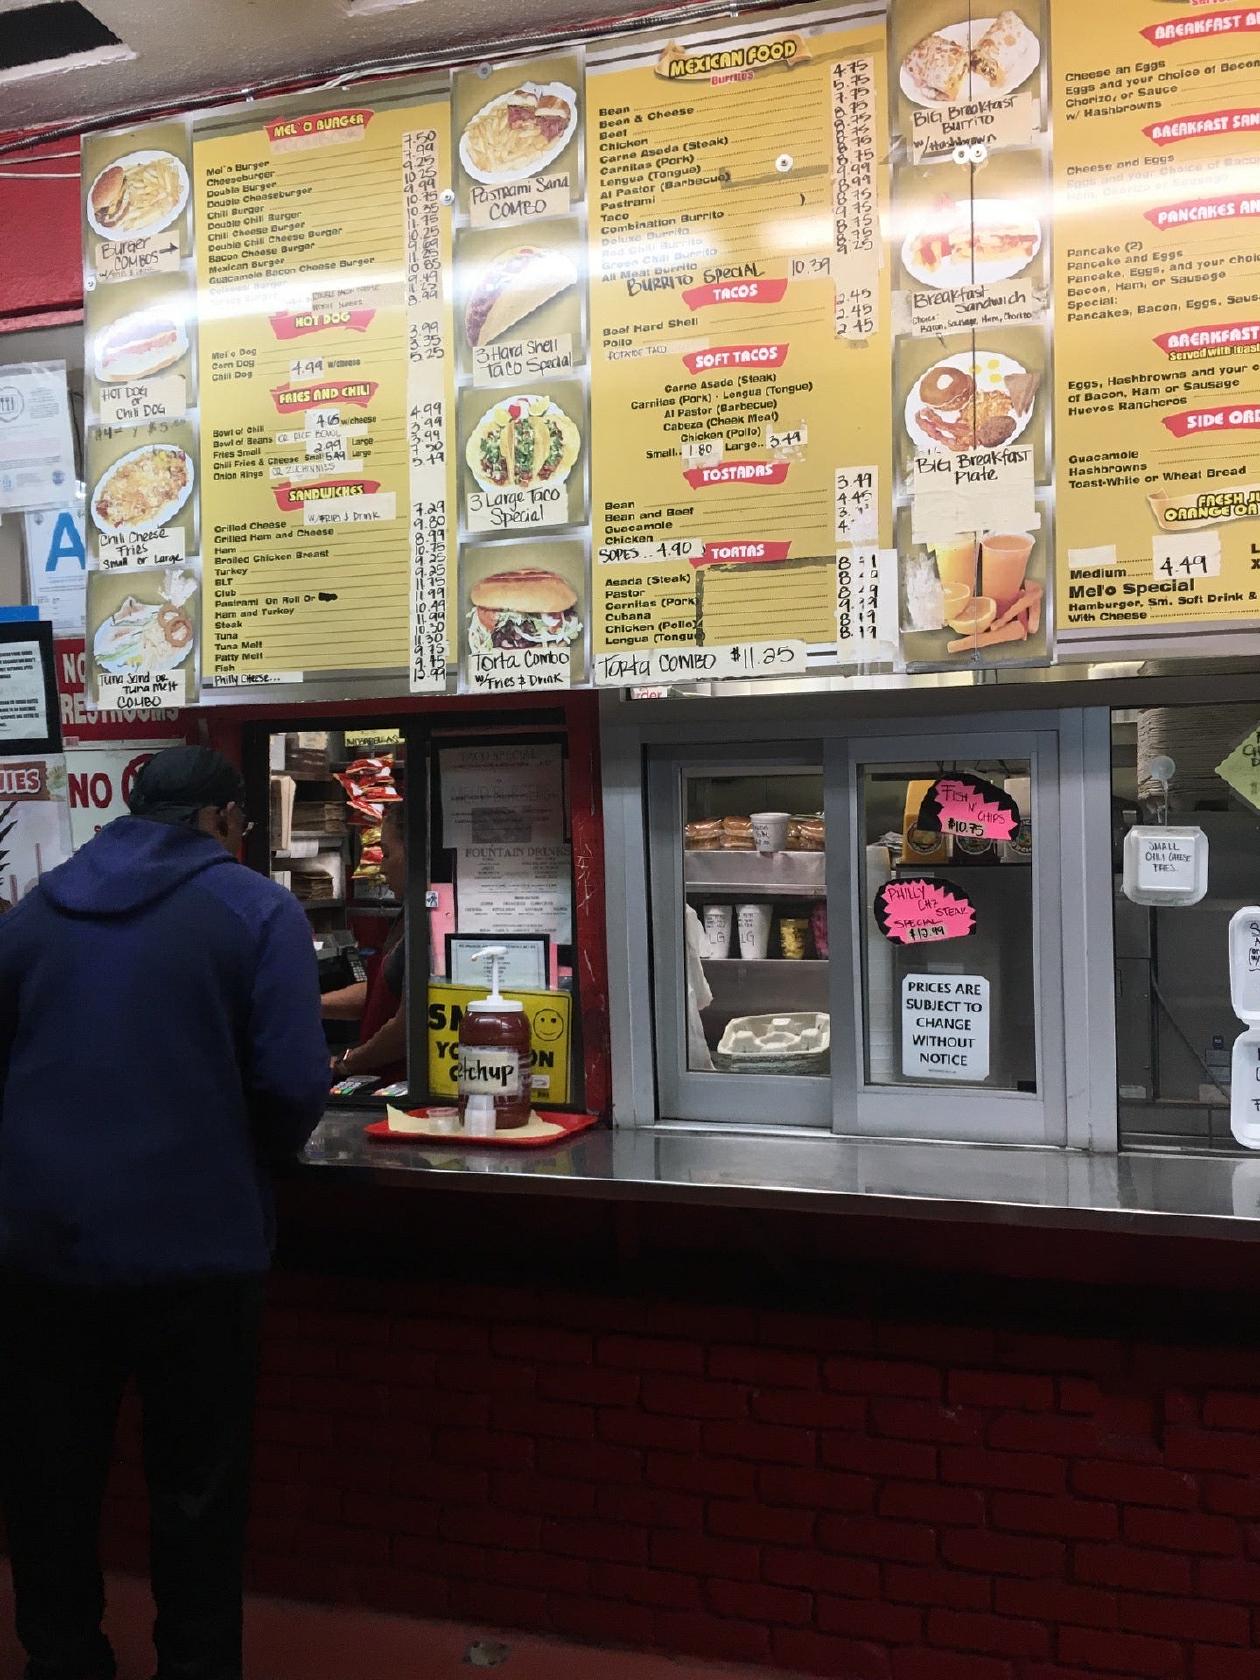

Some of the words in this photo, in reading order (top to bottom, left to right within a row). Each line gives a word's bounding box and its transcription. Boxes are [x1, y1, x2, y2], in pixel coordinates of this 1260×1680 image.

[1155, 15, 1242, 40] BREAKFAST
[669, 49, 745, 77] MEXICAN
[747, 41, 797, 64] FOOD
[711, 71, 754, 86] Burritos
[1065, 69, 1110, 82] Cheese
[1116, 66, 1130, 74] an
[1135, 59, 1166, 72] Eggs
[1066, 84, 1095, 95] Eggs
[1099, 79, 1122, 90] and
[1126, 75, 1154, 87] your
[1204, 66, 1215, 74] of
[599, 106, 630, 117] Bean
[599, 117, 630, 128] Bean
[634, 114, 642, 123] &
[648, 107, 694, 121] Cheese
[317, 114, 364, 130] BURGER
[1152, 117, 1228, 139] BREAKFAST
[599, 129, 627, 140] Beef
[600, 152, 637, 164] Carne
[641, 145, 679, 157] Asada
[683, 137, 728, 151] (Steak)
[235, 161, 269, 172] Burger
[206, 171, 275, 186] Cheeseburger
[207, 188, 240, 197] Double
[243, 181, 276, 192] Burger
[490, 200, 546, 220] COMBO
[601, 197, 655, 210] Pastrami
[1158, 203, 1235, 224] PANCAKES
[601, 218, 676, 234] Combination
[681, 210, 724, 223] Burrito
[102, 237, 151, 259] Burger
[209, 253, 238, 262] Bacon
[241, 248, 277, 258] Cheese
[282, 242, 315, 253] Burger
[115, 251, 158, 270] COMBOS
[1068, 258, 1121, 270] Pancake
[1126, 254, 1148, 263] and
[1153, 249, 1183, 262] Eggs
[713, 284, 758, 298] TACOS
[295, 316, 319, 328] HOT
[323, 312, 350, 324] DOG
[603, 327, 630, 337] Beef
[634, 322, 664, 334] Hard
[668, 317, 698, 328] Shell
[409, 322, 438, 338] 3.99
[1168, 326, 1260, 348] BREAKFAST
[603, 337, 632, 347] Pollo
[476, 348, 490, 363] 3
[695, 353, 729, 368] SOFT
[732, 347, 778, 363] TACOS
[292, 360, 323, 375] 4.99
[280, 391, 310, 404] FRIES
[314, 388, 338, 400] AND
[342, 384, 370, 397] CHILI
[117, 406, 139, 419] Chili
[144, 404, 165, 416] DOG
[664, 409, 674, 418] Al
[678, 406, 712, 416] Pastor
[717, 399, 777, 414] (Barbecue)
[1069, 403, 1114, 416] Huevos
[1119, 397, 1187, 410] Rancheros
[1187, 415, 1223, 429] SIDE
[213, 429, 234, 437] Bowl
[248, 425, 264, 434] Chili
[352, 437, 373, 447] Large
[213, 450, 235, 459] Fries
[237, 448, 261, 457] Small
[1069, 450, 1139, 464] Guacamole
[214, 460, 232, 470] Chili
[235, 459, 256, 468] Fries
[259, 458, 264, 466] &
[268, 456, 299, 465] Cheese
[916, 457, 951, 473] BIG
[214, 472, 240, 480] Onion
[241, 470, 263, 479] Rings
[702, 464, 773, 481] TOSTADAS
[289, 485, 364, 502] SANDWICHES
[470, 496, 482, 511] 3
[486, 492, 524, 512] Large
[529, 486, 560, 501] Taco
[1198, 492, 1244, 507] FRESH
[414, 501, 445, 515] 7.29
[491, 504, 543, 527] Special
[1165, 504, 1230, 521] ORANGE
[1235, 503, 1259, 515] OR
[605, 520, 672, 534] Guacamole
[46, 512, 85, 572] A
[100, 535, 126, 546] Chili
[129, 529, 168, 543] Cheese
[215, 534, 247, 544] Grilled
[250, 532, 271, 540] Ham
[275, 530, 293, 539] and
[297, 527, 334, 537] Cheese
[415, 529, 444, 545] 8.99
[215, 546, 236, 554] Ham
[215, 556, 249, 565] Broiled
[253, 553, 292, 563] Chicken
[296, 550, 329, 560] Breast
[711, 544, 764, 559] TORTAS
[215, 568, 248, 576] Turkey
[1070, 569, 1127, 579] Medium
[1161, 556, 1207, 576] 4.49
[215, 578, 233, 586] BLT
[1069, 584, 1117, 598] Mel'o
[1123, 578, 1195, 595] Special
[215, 589, 236, 597] Club
[606, 588, 644, 598] Pastor
[606, 611, 651, 621] Cubana
[215, 653, 239, 662] Patty
[242, 652, 263, 660] Melt
[472, 652, 520, 671] Torta
[660, 654, 716, 670] COMBO
[730, 646, 794, 669] $11.25
[68, 773, 112, 808] NO
[978, 811, 1005, 824] CHIPS
[948, 818, 983, 836] $10.75
[465, 848, 523, 858] FOUNTAIN
[888, 886, 925, 901] PHILLY
[908, 982, 952, 993] PRICES
[955, 984, 980, 995] ARE
[906, 999, 960, 1012] SUBJECT
[964, 1002, 982, 1012] TO
[916, 1018, 971, 1030] CHANGE
[913, 1034, 976, 1048] WITHOUT
[920, 1053, 967, 1066] NOTICE
